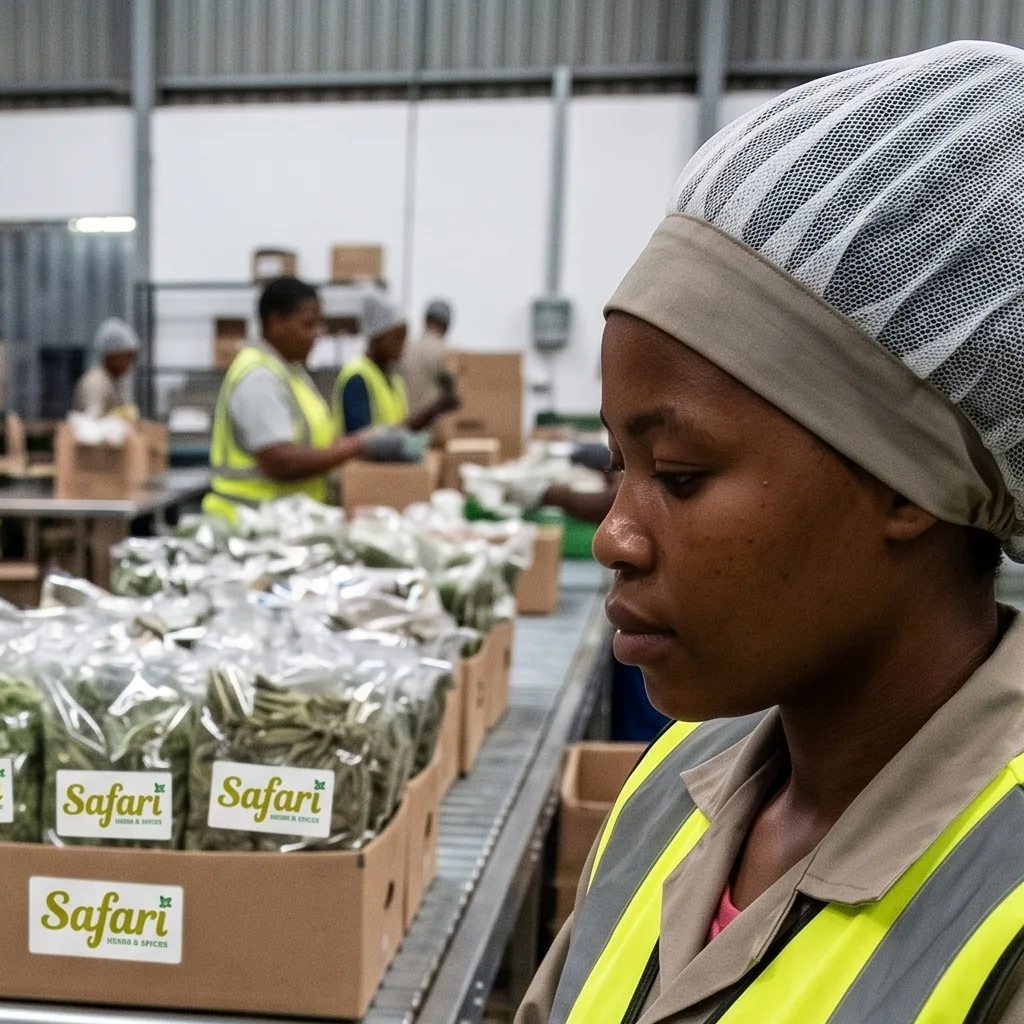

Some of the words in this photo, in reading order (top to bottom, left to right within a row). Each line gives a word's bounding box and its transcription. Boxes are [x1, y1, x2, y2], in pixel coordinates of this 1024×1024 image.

[62, 782, 162, 828] Safari
[218, 776, 321, 823] Safari
[41, 890, 169, 949] Safari
